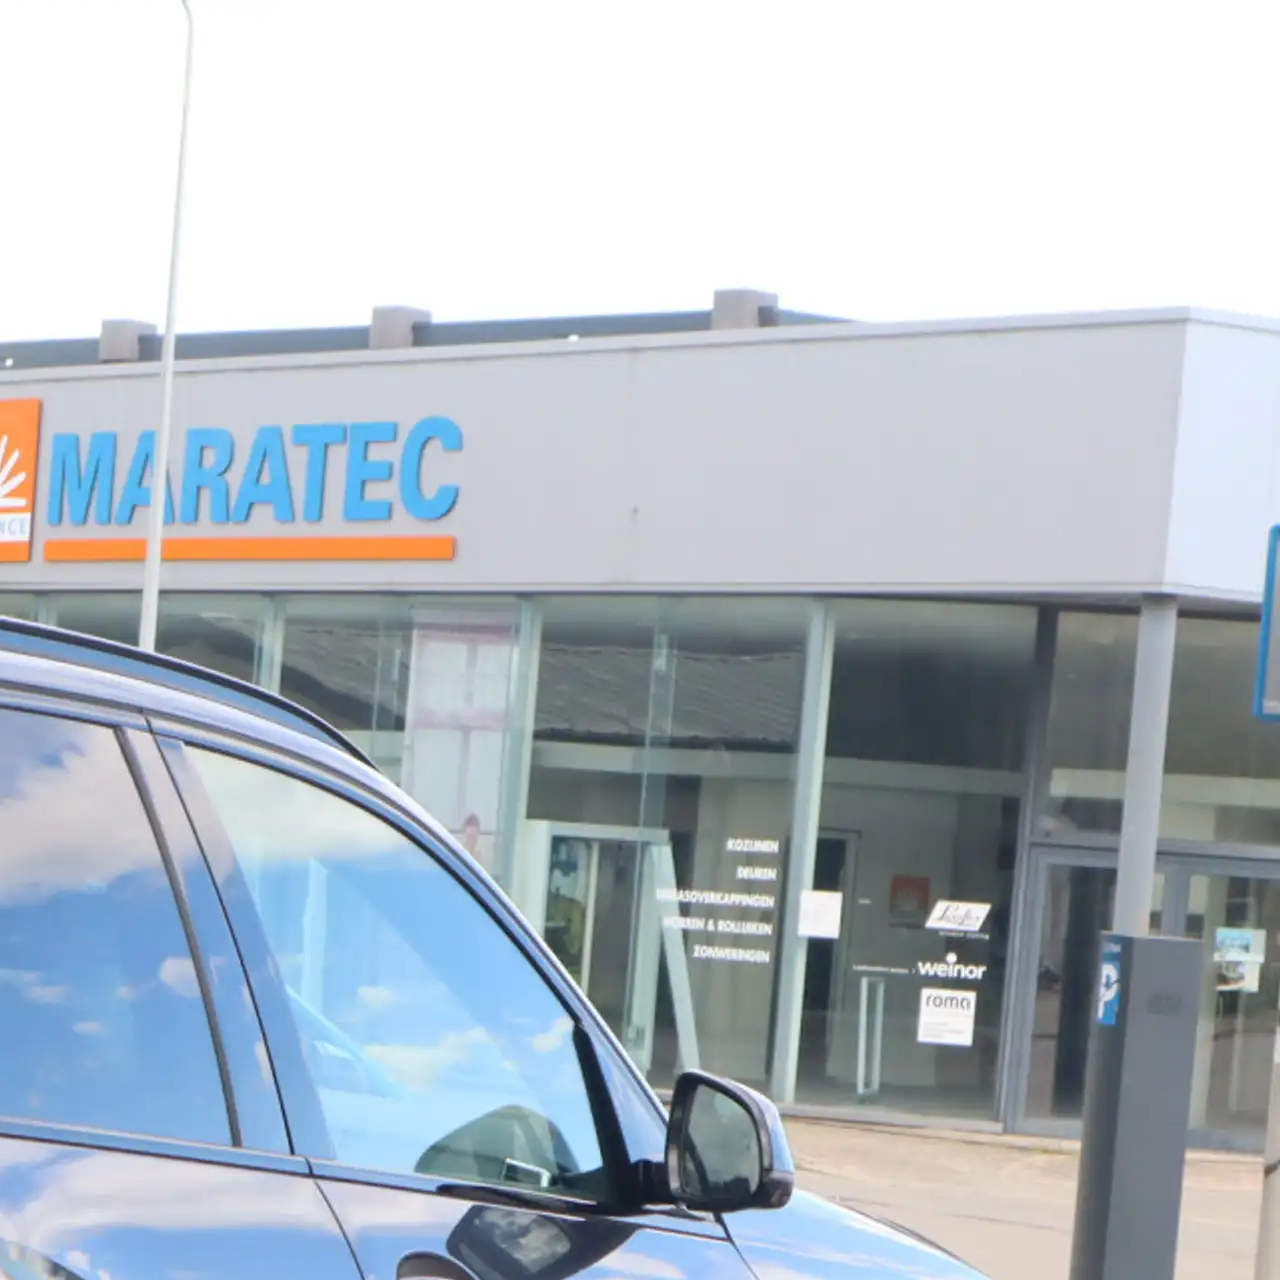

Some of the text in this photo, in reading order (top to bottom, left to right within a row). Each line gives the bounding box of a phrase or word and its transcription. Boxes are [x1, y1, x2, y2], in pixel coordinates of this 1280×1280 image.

[46, 416, 464, 526] MARATEC
[917, 952, 987, 980] weinor
[925, 993, 971, 1010] roma
